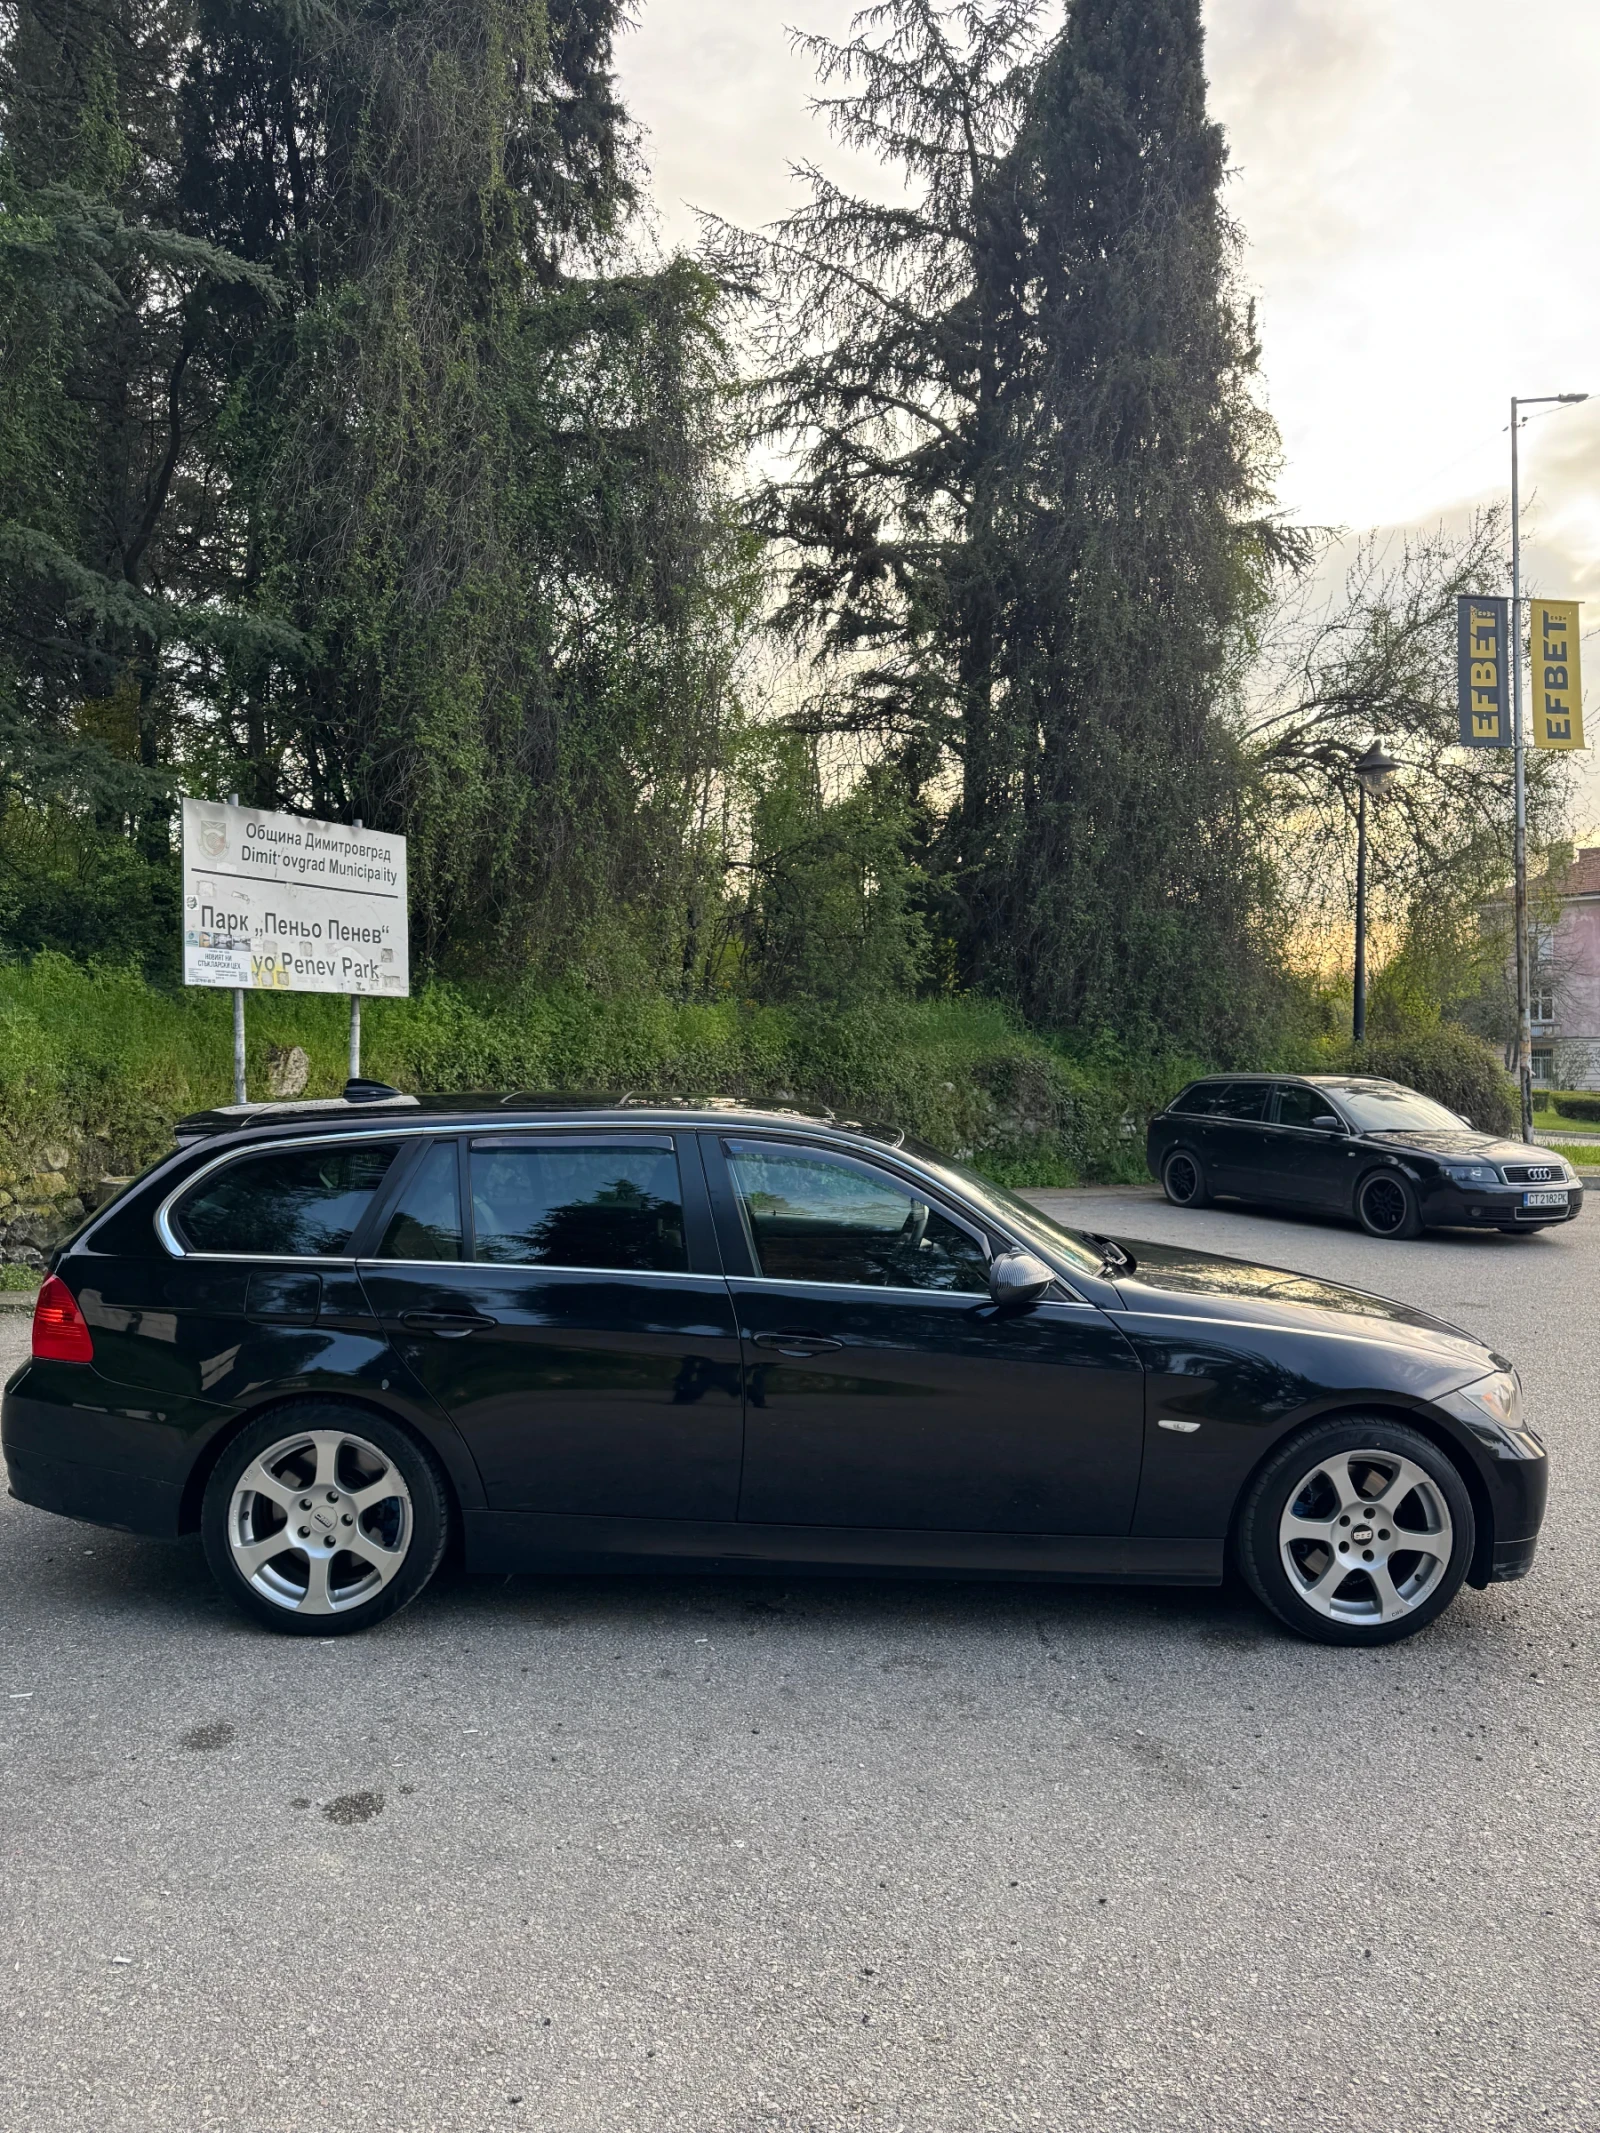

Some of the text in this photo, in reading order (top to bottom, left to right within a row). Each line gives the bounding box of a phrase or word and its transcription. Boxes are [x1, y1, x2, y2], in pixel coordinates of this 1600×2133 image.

[1470, 605, 1499, 738] EFBET
[1543, 610, 1572, 740] EFBET
[241, 845, 326, 873] Dimitovgrad
[246, 822, 392, 863] Община Димитровград
[201, 905, 390, 944] Парк „Пеньо Пенев“
[282, 952, 335, 976] Penev
[342, 956, 380, 979] Park
